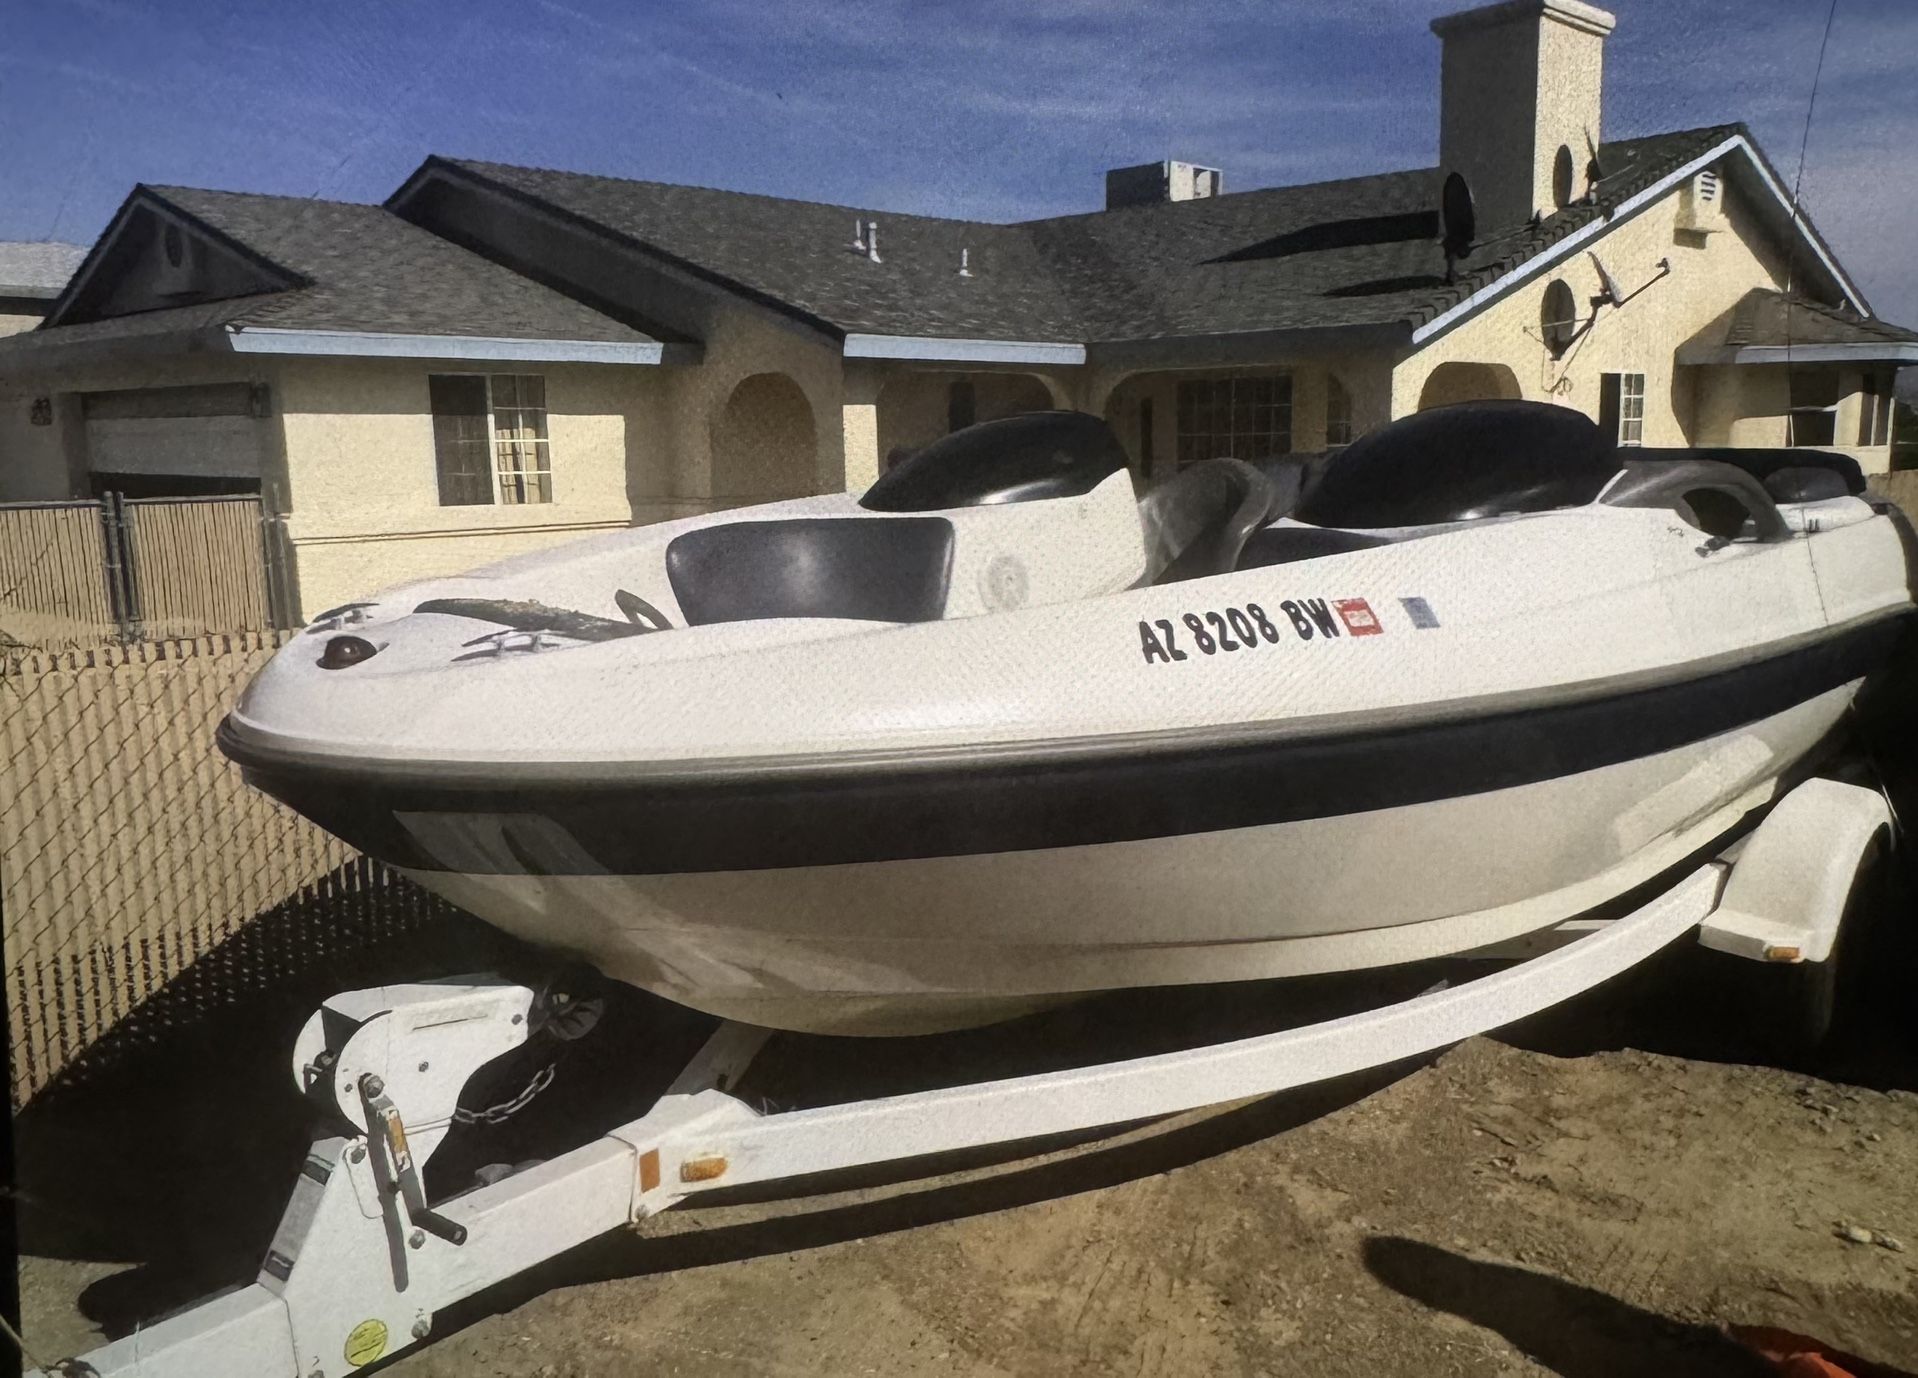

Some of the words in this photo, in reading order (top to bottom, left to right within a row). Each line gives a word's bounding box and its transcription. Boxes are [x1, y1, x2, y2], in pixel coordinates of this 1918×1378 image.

[1139, 618, 1188, 664] AZ
[1183, 603, 1280, 655] 8208
[1280, 597, 1340, 640] BW
